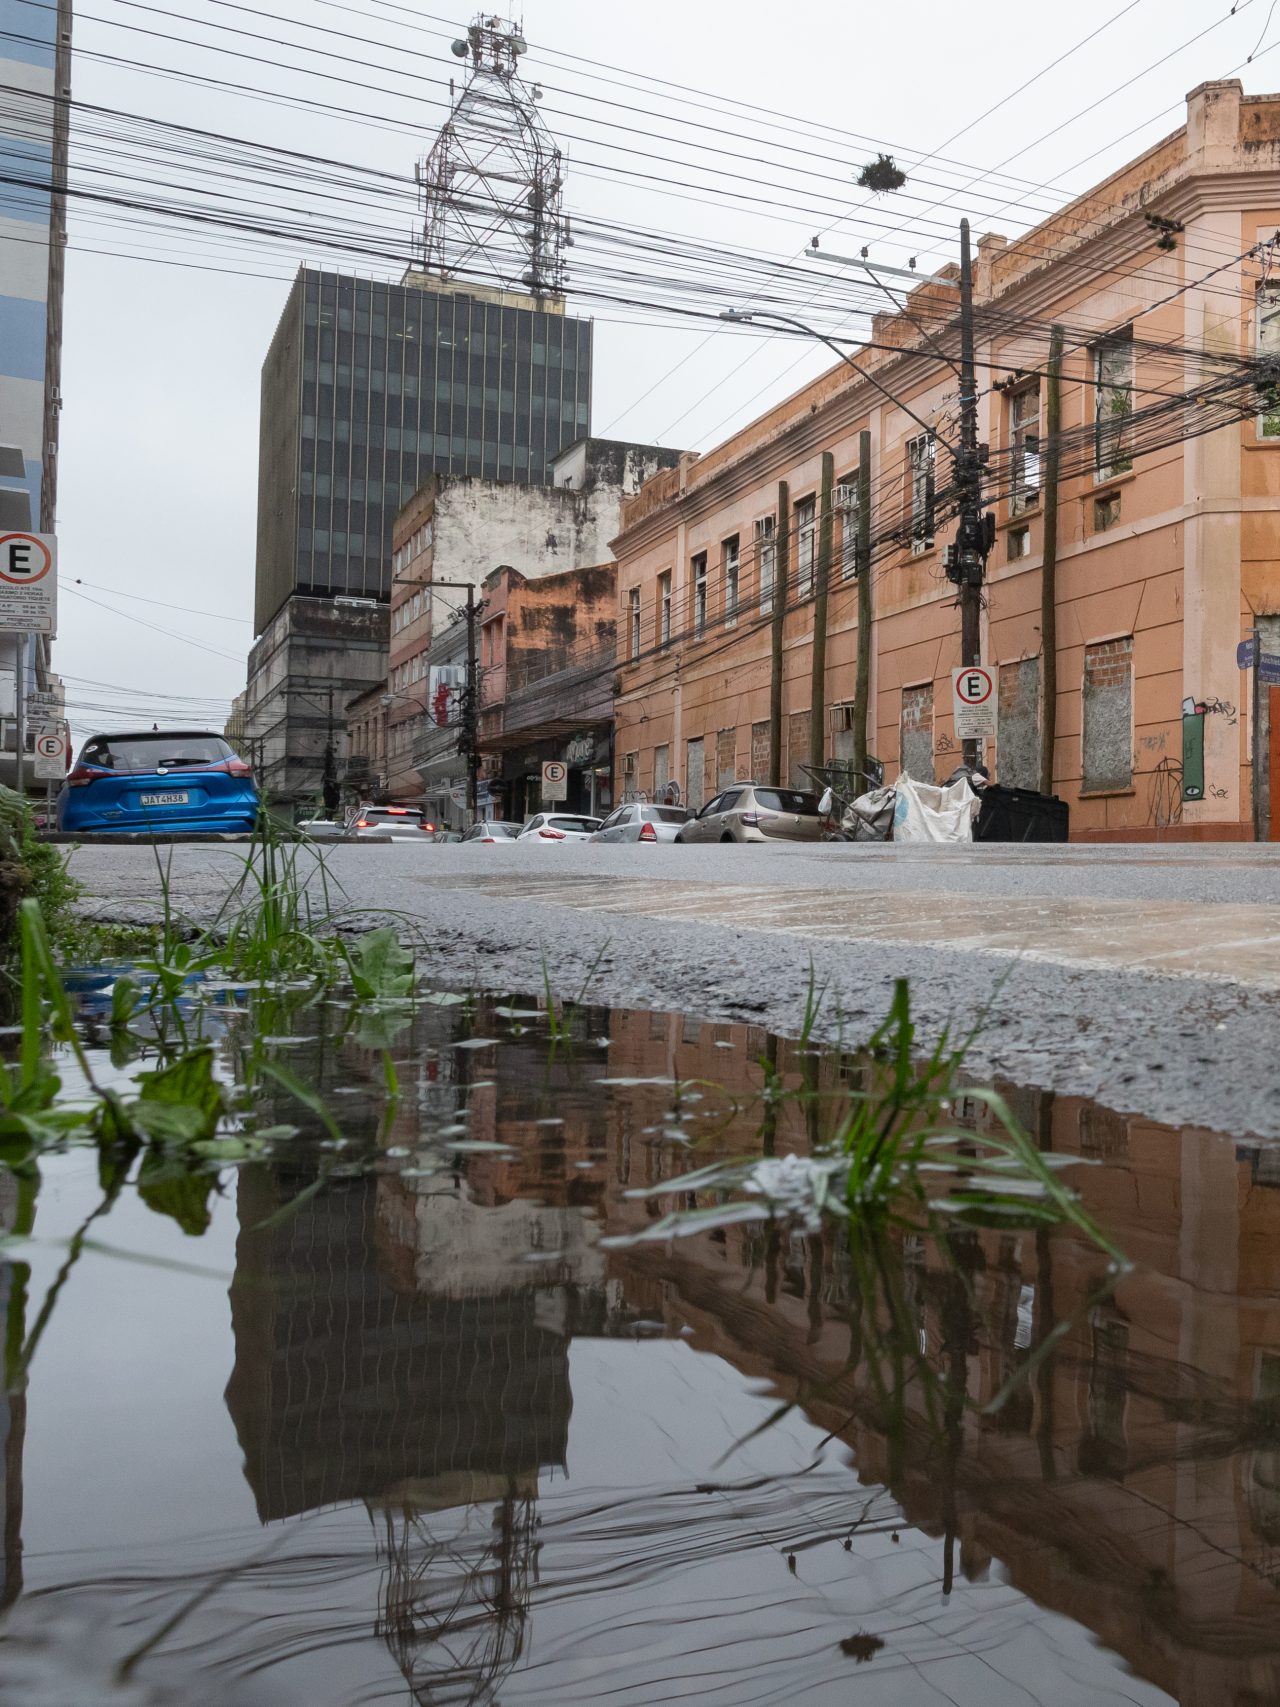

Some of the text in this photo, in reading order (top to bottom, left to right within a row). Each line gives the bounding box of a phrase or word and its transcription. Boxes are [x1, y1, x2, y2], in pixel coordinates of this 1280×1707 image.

[9, 544, 31, 573] E
[967, 676, 981, 697] E
[45, 740, 56, 753] E
[550, 767, 559, 778] E
